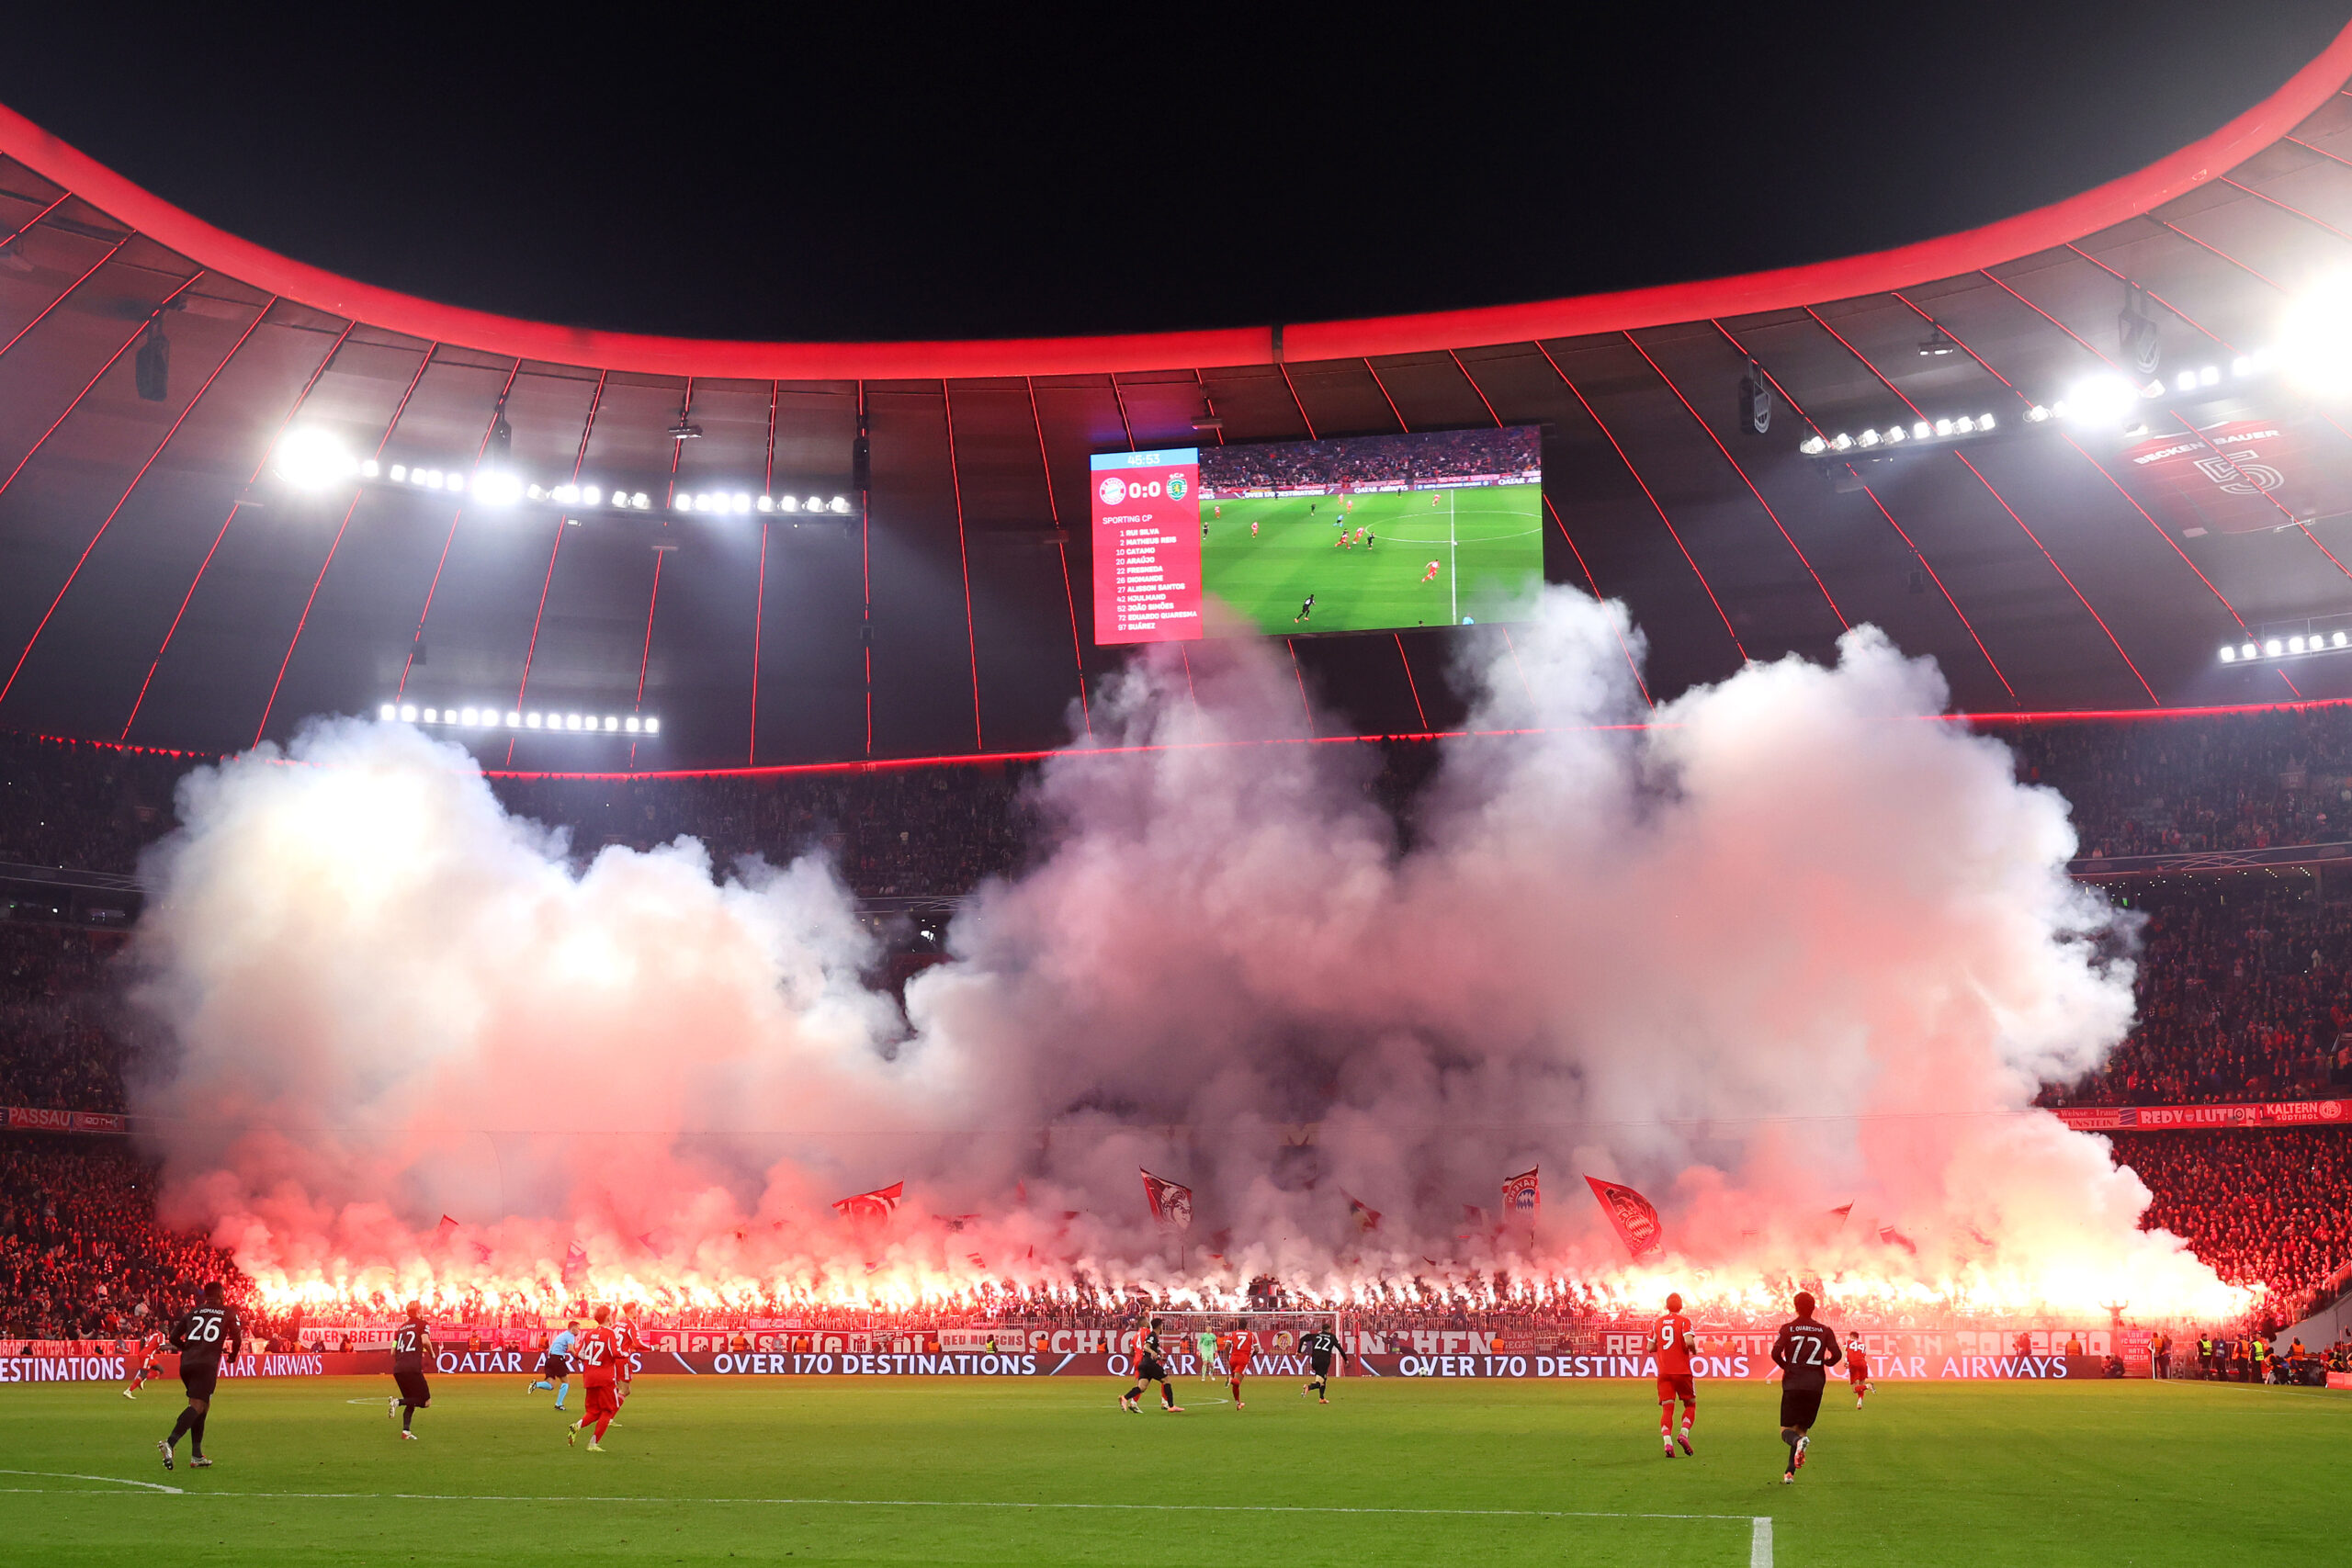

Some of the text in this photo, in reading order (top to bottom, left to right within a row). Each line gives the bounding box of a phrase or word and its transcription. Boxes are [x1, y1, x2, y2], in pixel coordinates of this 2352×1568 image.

[2193, 449, 2285, 495] 5
[1128, 481, 1161, 499] 0:0
[1102, 514, 1153, 525] SPORTING CP
[1125, 537, 1159, 546] MATHEUS
[1126, 575, 1163, 583] DIOMANDE
[1127, 594, 1166, 603] HJULMAND
[9, 1107, 71, 1126] PASSAU
[2267, 1102, 2318, 1115] KALTERN
[187, 1315, 222, 1343] 26
[350, 1330, 399, 1343] BRETT
[1661, 1325, 1674, 1350] 9
[397, 1331, 416, 1353] 42
[944, 1335, 967, 1347] RED
[1136, 1335, 1143, 1348] 4
[1237, 1335, 1247, 1350] 7
[1314, 1336, 1331, 1352] 22
[1791, 1335, 1822, 1366] 72
[1849, 1340, 1865, 1354] 44
[436, 1352, 523, 1374] QATAR
[584, 1340, 605, 1367] 42
[262, 1355, 323, 1376] AIRWAYS
[713, 1353, 1037, 1376] OVER 170 DESTINATIONS
[1106, 1353, 1197, 1377] QAR
[1399, 1355, 1750, 1378] OVER 170 DESTINAONS
[1940, 1356, 2068, 1379] AIRWAYS
